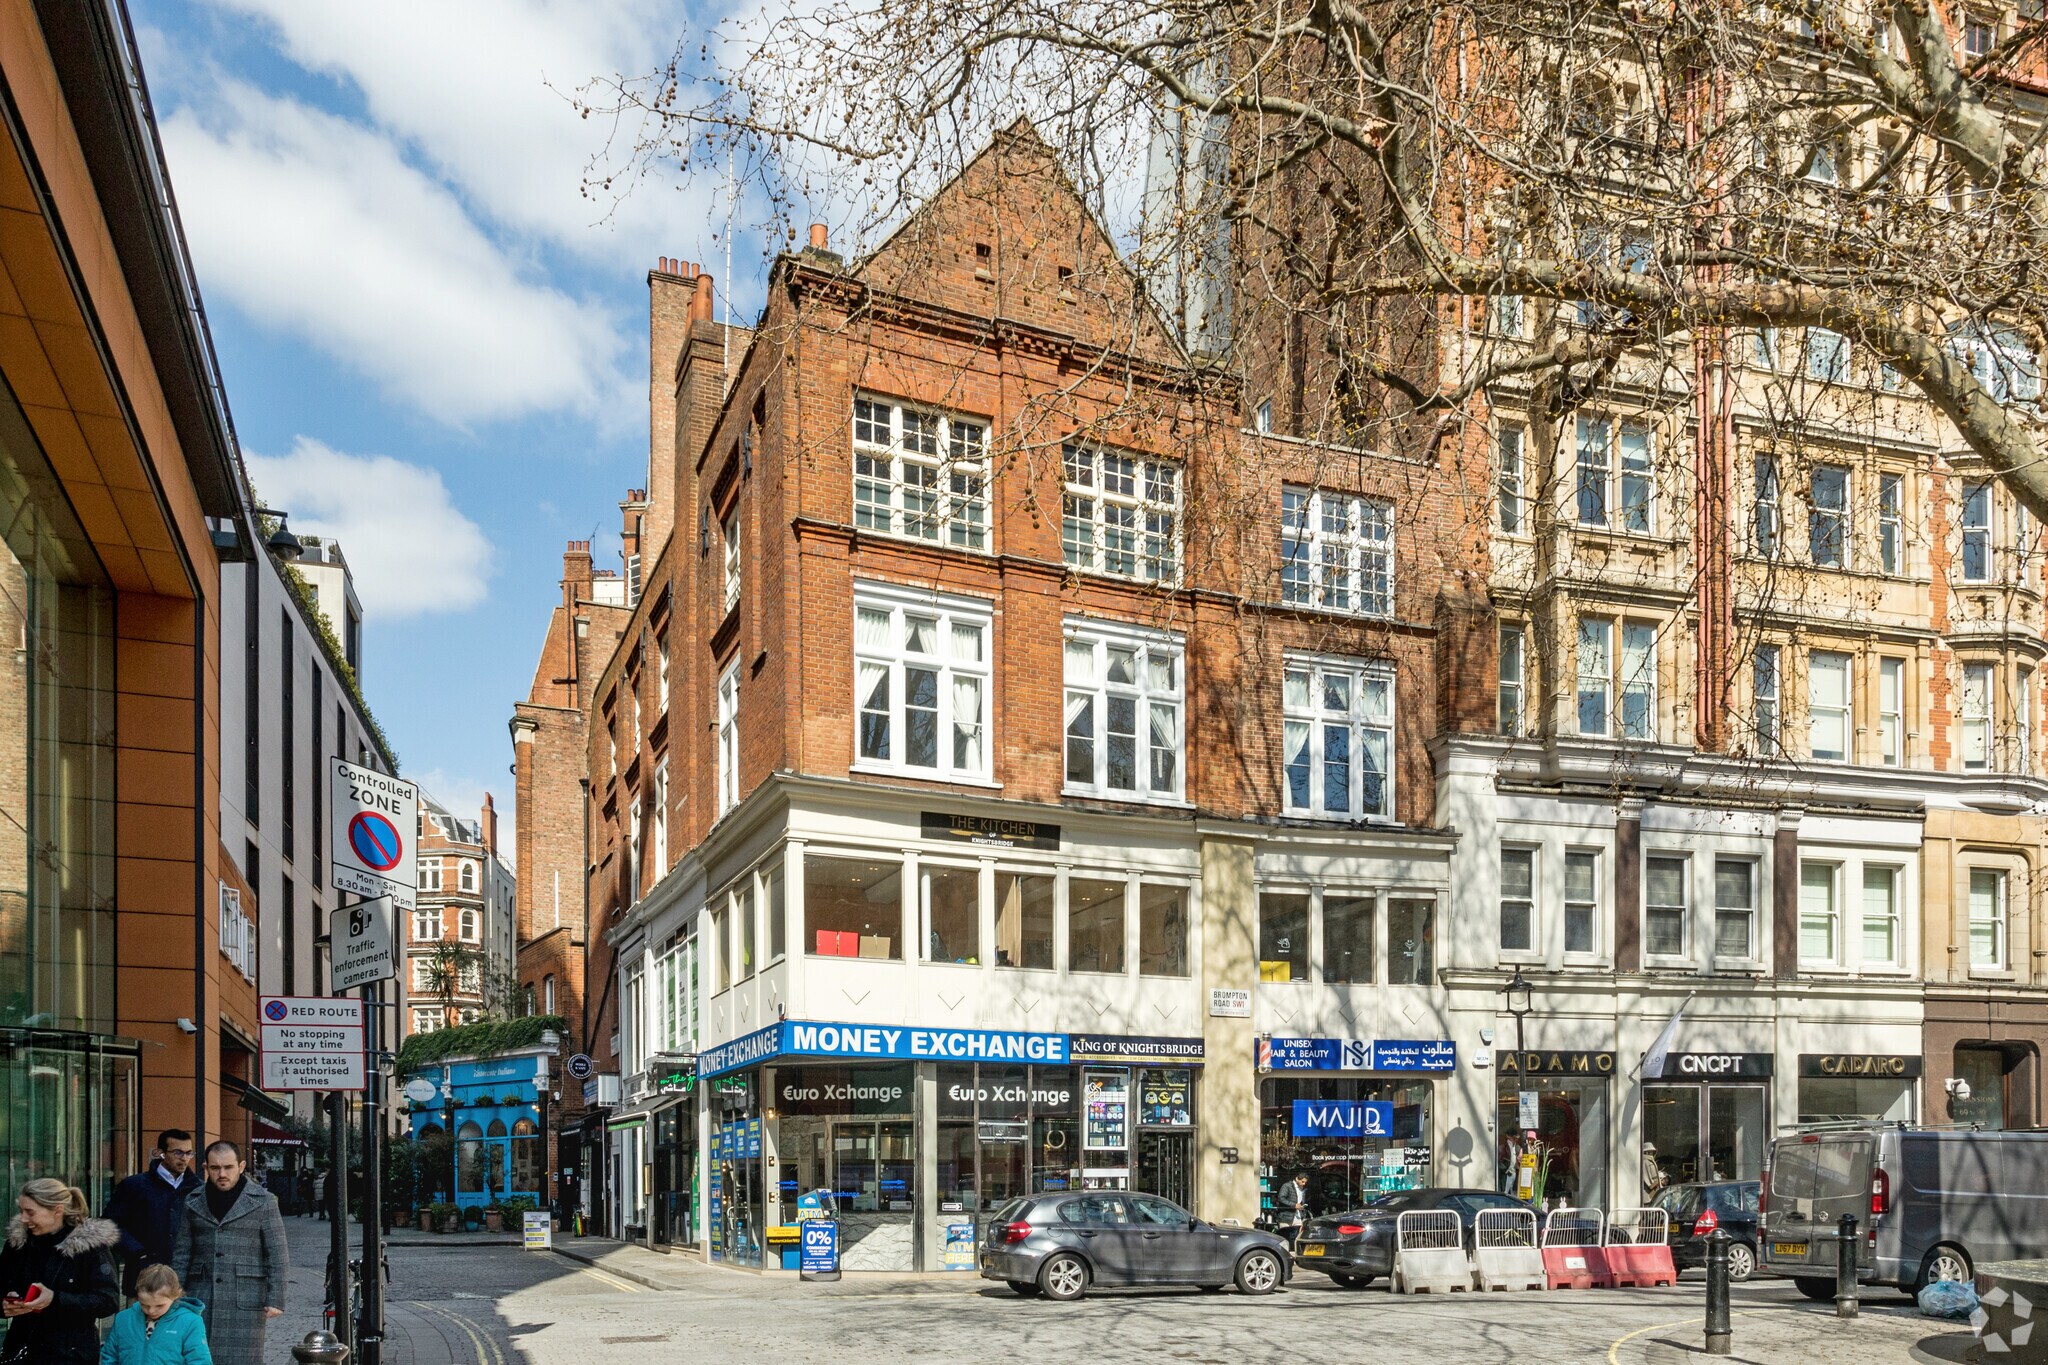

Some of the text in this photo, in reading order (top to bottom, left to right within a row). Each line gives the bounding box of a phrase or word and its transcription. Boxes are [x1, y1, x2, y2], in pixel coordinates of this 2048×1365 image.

[338, 764, 412, 800] Controlled
[349, 784, 401, 815] ZONE
[949, 815, 1036, 835] THE KITCHEN
[971, 837, 1014, 847] KNIGHTSBRIDGE
[356, 873, 374, 885] Mon
[382, 881, 397, 892] Sat
[337, 877, 358, 890] 8.30
[359, 885, 372, 894] am
[400, 898, 412, 907] pm
[346, 939, 375, 955] Traffic
[334, 949, 389, 973] enforcement
[343, 967, 379, 985] cameras
[1213, 990, 1248, 1000] BROMPTON
[1213, 999, 1231, 1008] ROAD
[291, 1007, 358, 1017] RED ROUTE
[280, 1029, 345, 1040] No stopping
[283, 1040, 343, 1050] at any time
[793, 1025, 1063, 1060] MONEY EXCHANGE
[1072, 1041, 1203, 1055] KING OF KNIGHTSBRIDGE
[1284, 1040, 1312, 1048] UNISEX
[1422, 1042, 1453, 1057] صالون
[700, 1028, 778, 1076] MONEY EXCHANGE
[1290, 1050, 1296, 1058] &
[1299, 1050, 1328, 1058] BEAUTY
[281, 1056, 347, 1066] Except taxis
[1284, 1059, 1312, 1067] SALON
[1422, 1058, 1453, 1070] مجيد
[1501, 1052, 1613, 1072] ADAMO
[1680, 1055, 1743, 1073] CNCPT
[1820, 1055, 1905, 1074] CADARO
[293, 1066, 349, 1075] authorised
[300, 1077, 329, 1085] times
[783, 1084, 903, 1102] €uro Xchange
[1307, 1106, 1381, 1130] MAJID
[1365, 1123, 1386, 1135] Salon
[800, 1210, 822, 1219] ATM
[806, 1230, 832, 1245] 0%
[946, 1241, 975, 1253] ATM
[945, 1252, 975, 1264] HERE
